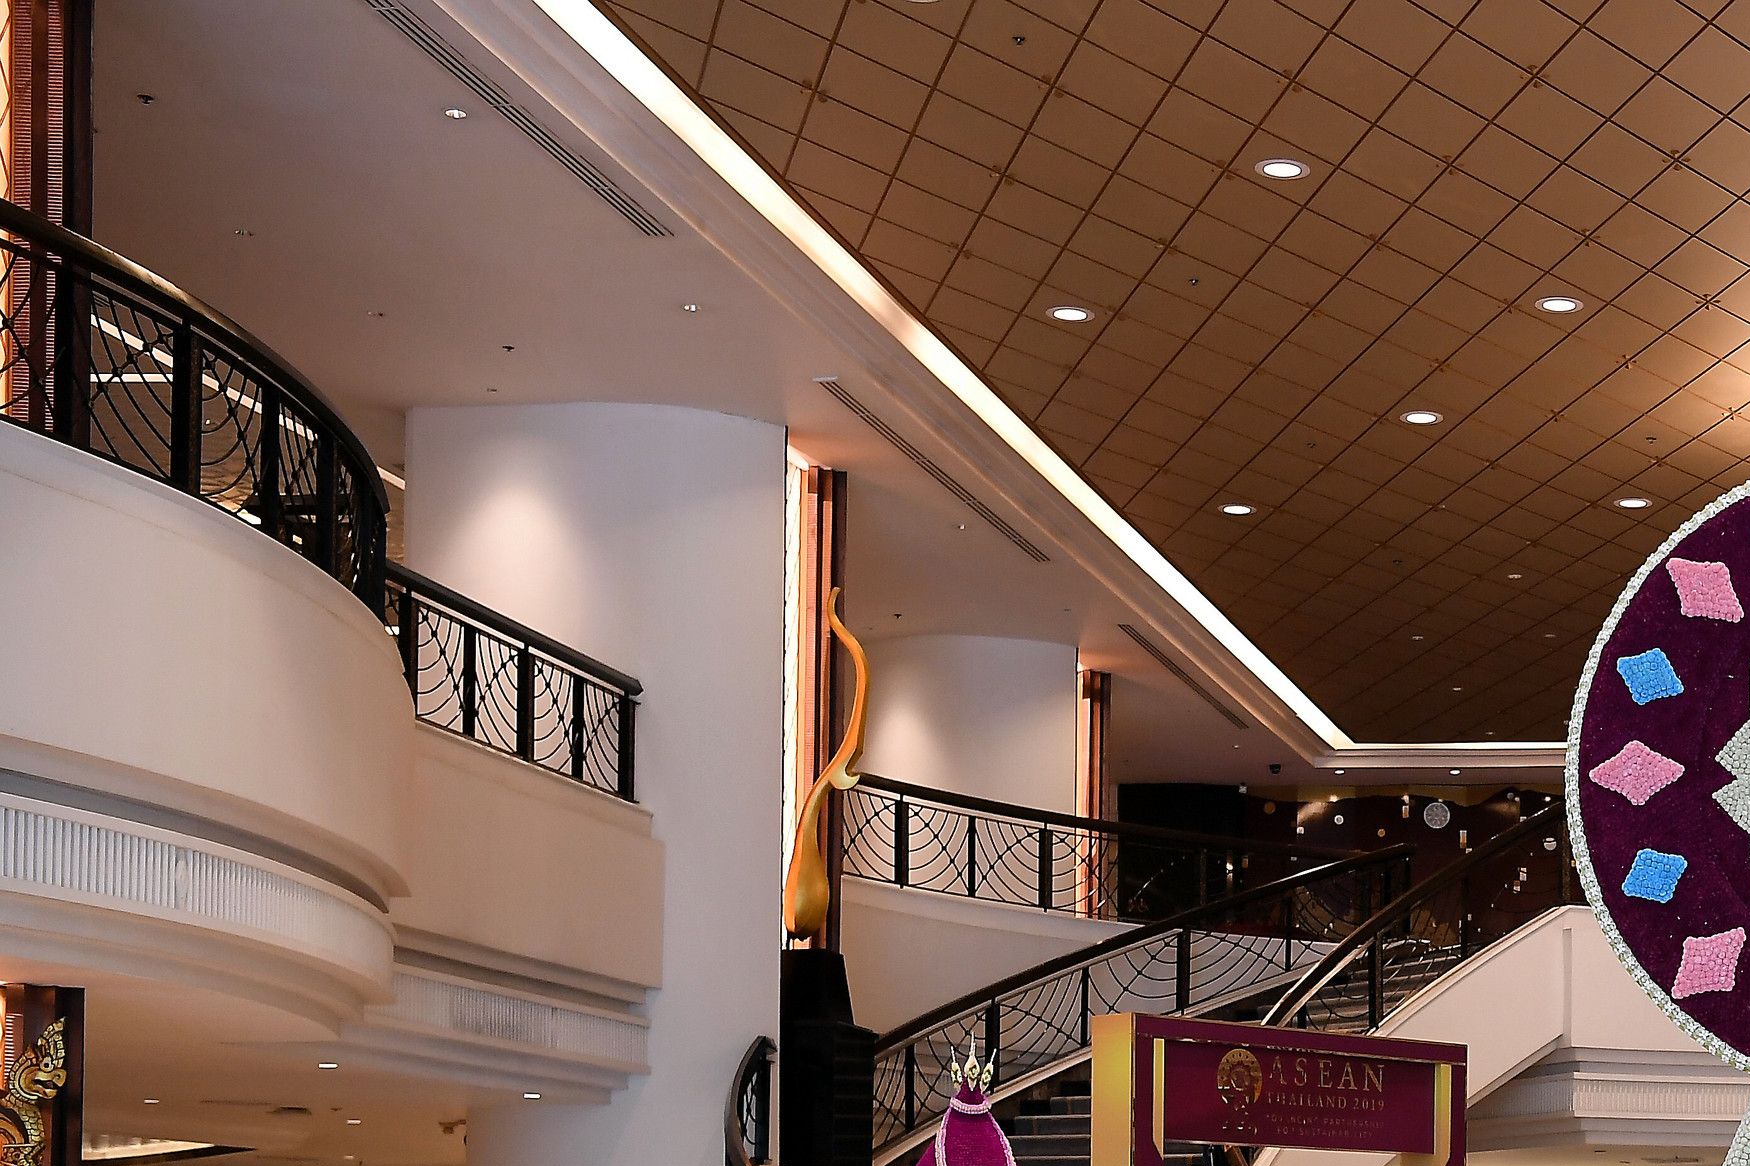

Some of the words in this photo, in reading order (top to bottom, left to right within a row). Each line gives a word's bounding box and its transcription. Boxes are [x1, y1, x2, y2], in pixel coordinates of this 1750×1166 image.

[1269, 1055, 1385, 1093] ASEAN
[1266, 1090, 1347, 1109] THAILAND
[1353, 1097, 1385, 1111] 2019
